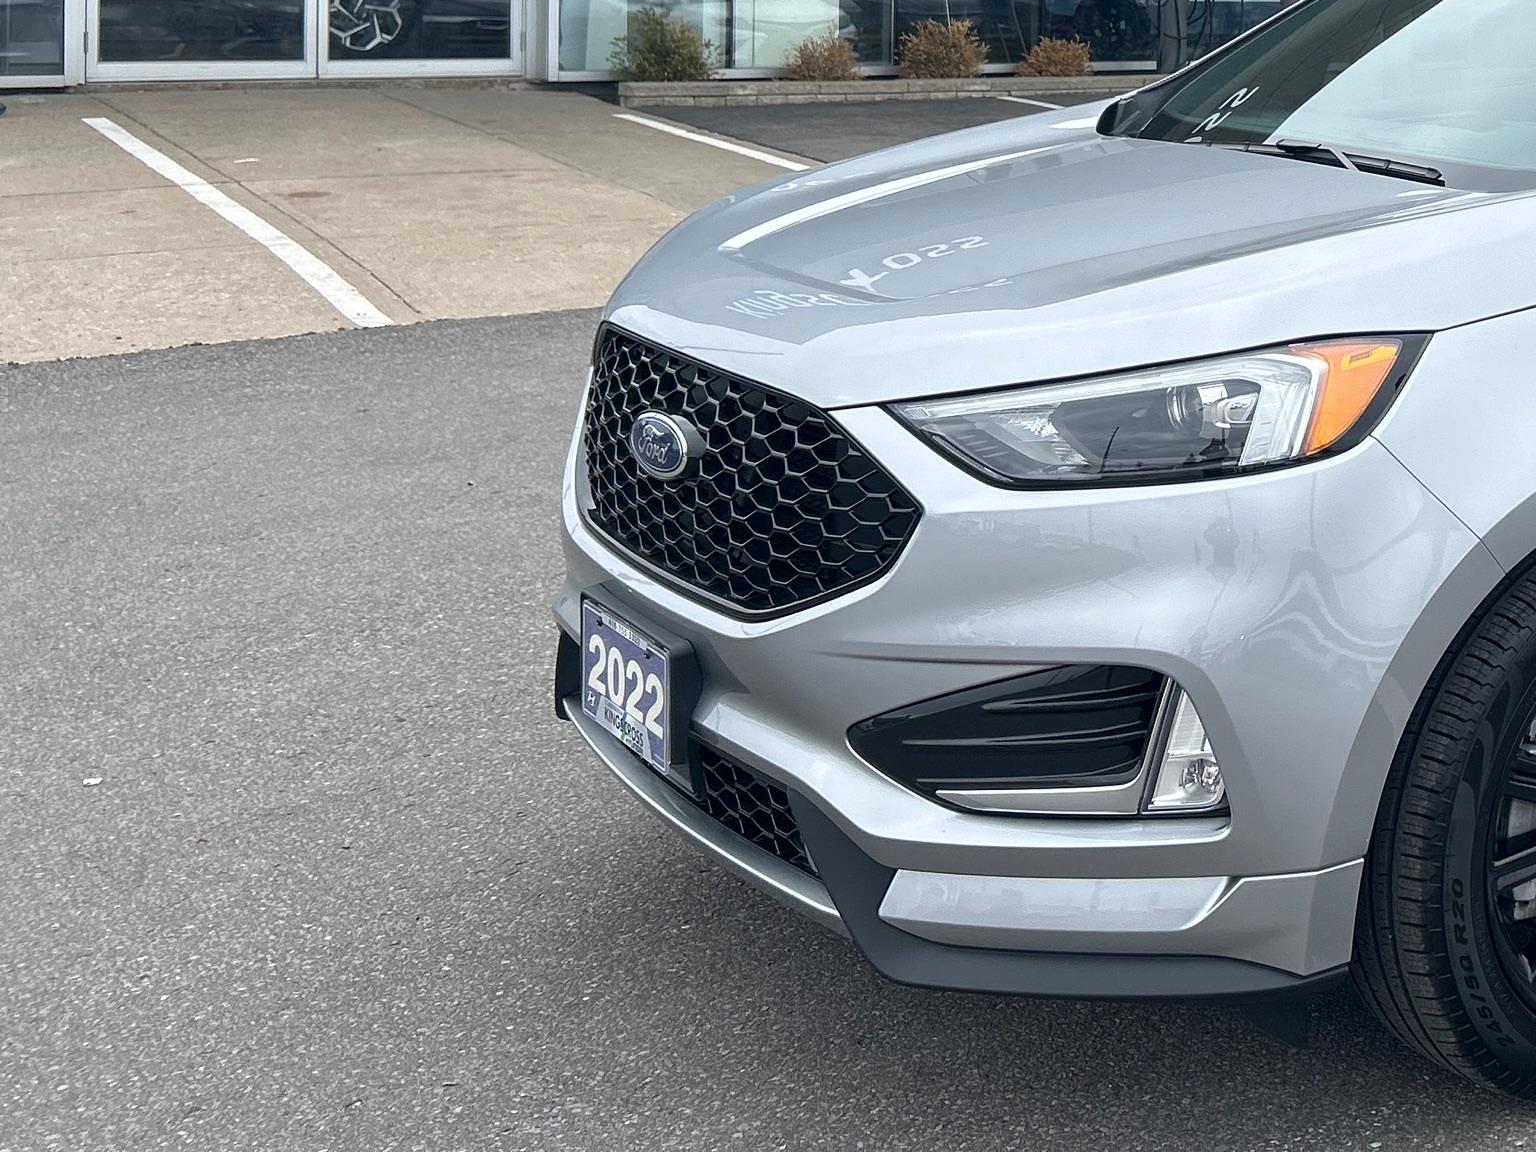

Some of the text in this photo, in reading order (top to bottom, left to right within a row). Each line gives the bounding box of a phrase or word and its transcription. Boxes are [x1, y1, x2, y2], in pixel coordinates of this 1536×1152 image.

[639, 424, 671, 465] Ford
[588, 634, 664, 740] 2022
[604, 705, 644, 747] KINGSCROSS
